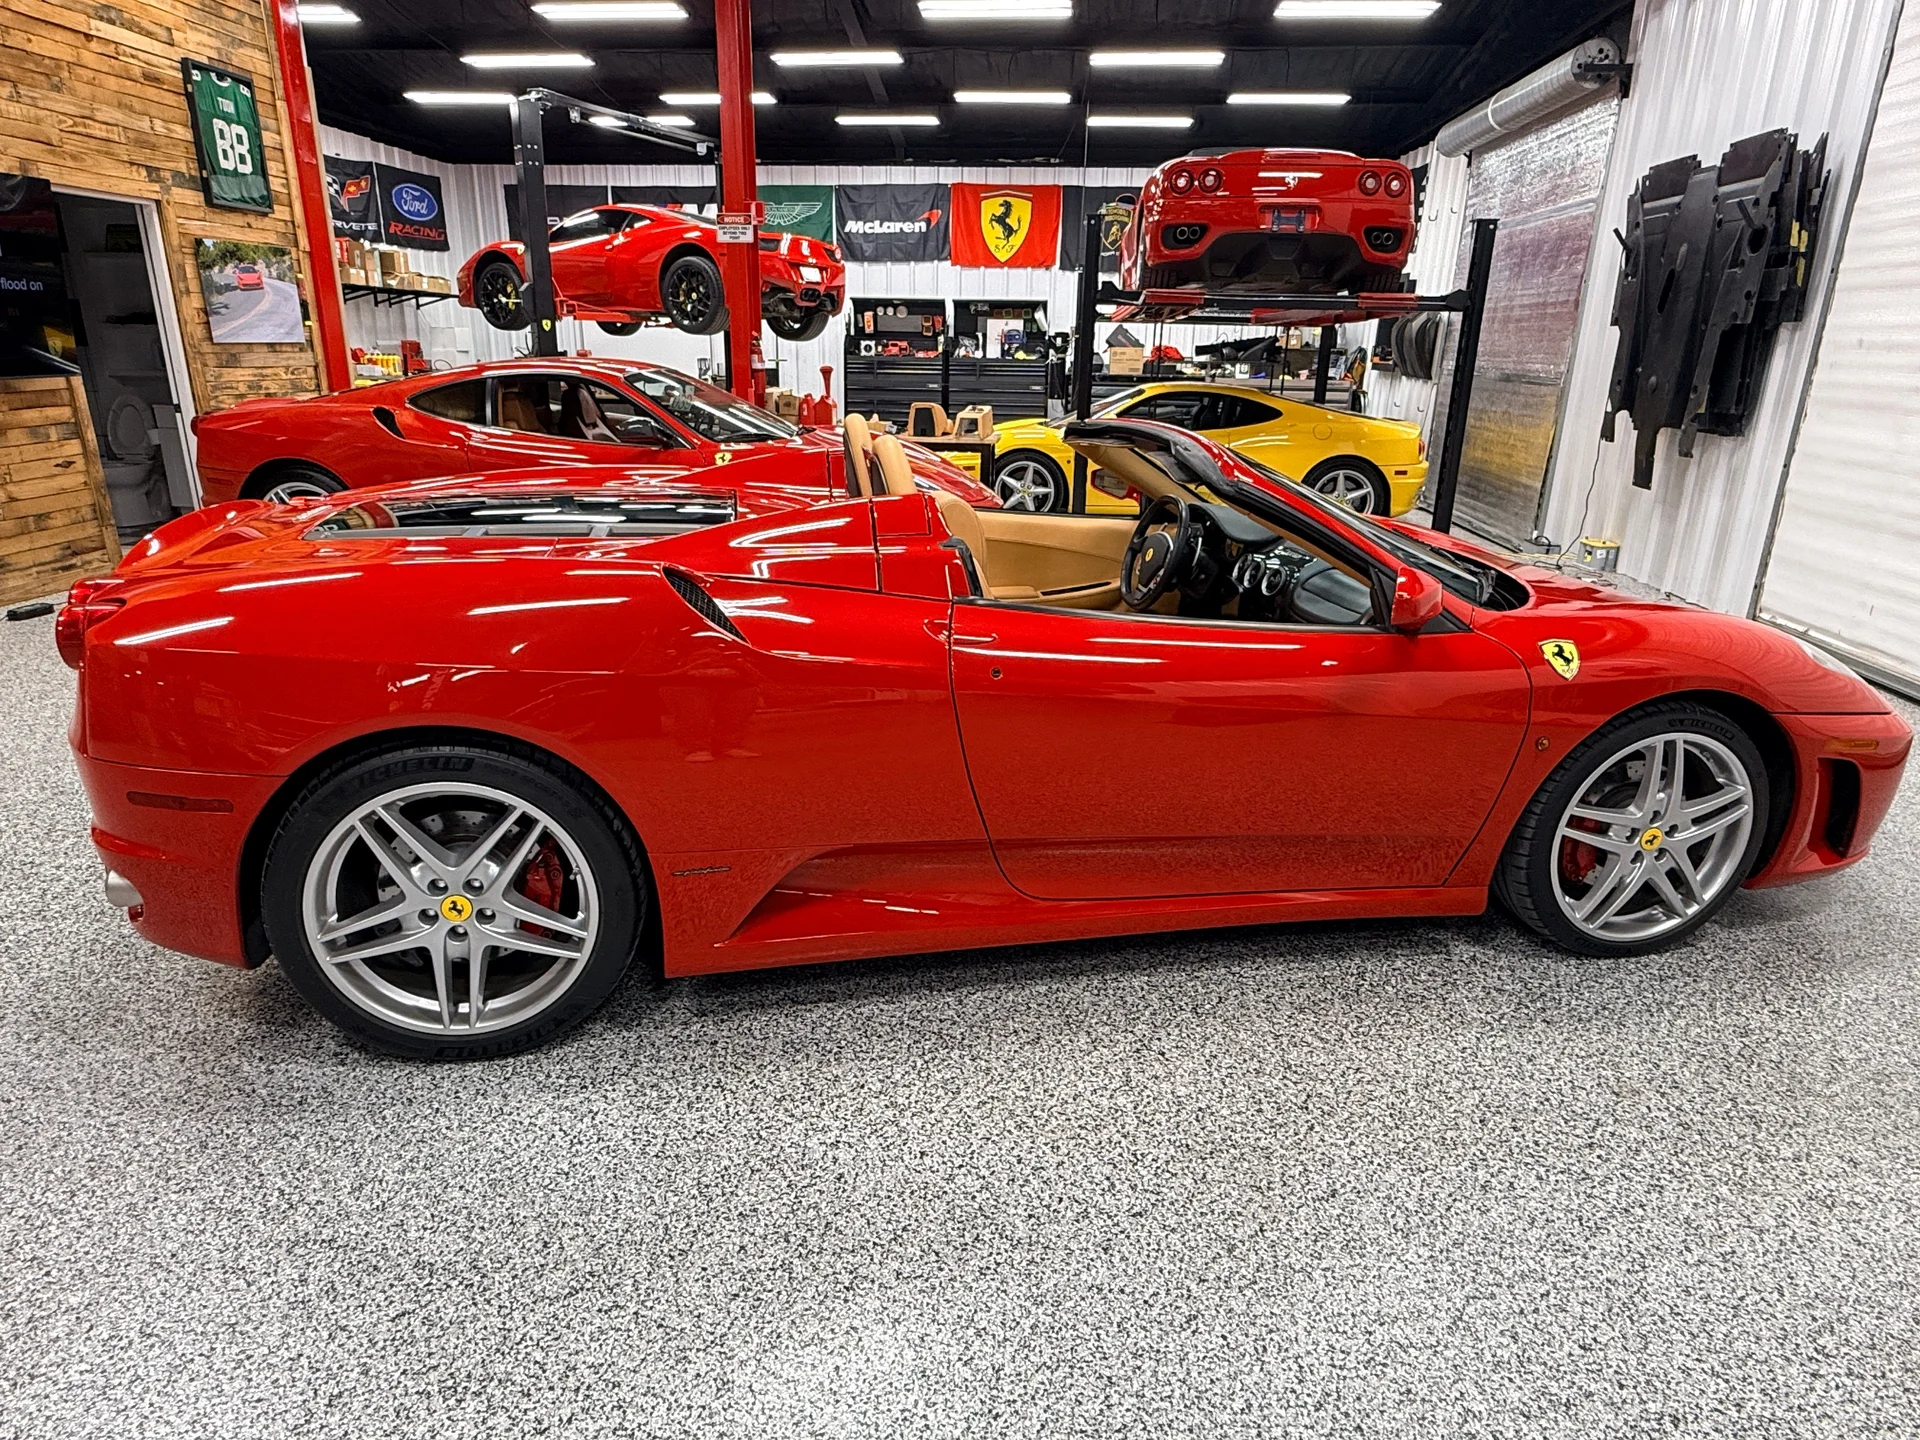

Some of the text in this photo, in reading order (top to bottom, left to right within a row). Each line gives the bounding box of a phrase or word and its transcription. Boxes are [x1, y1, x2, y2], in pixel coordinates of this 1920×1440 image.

[212, 117, 254, 175] 88
[401, 187, 429, 214] Ford
[388, 221, 445, 241] RACING
[843, 219, 927, 234] McLaren
[0, 277, 44, 291] flood on
